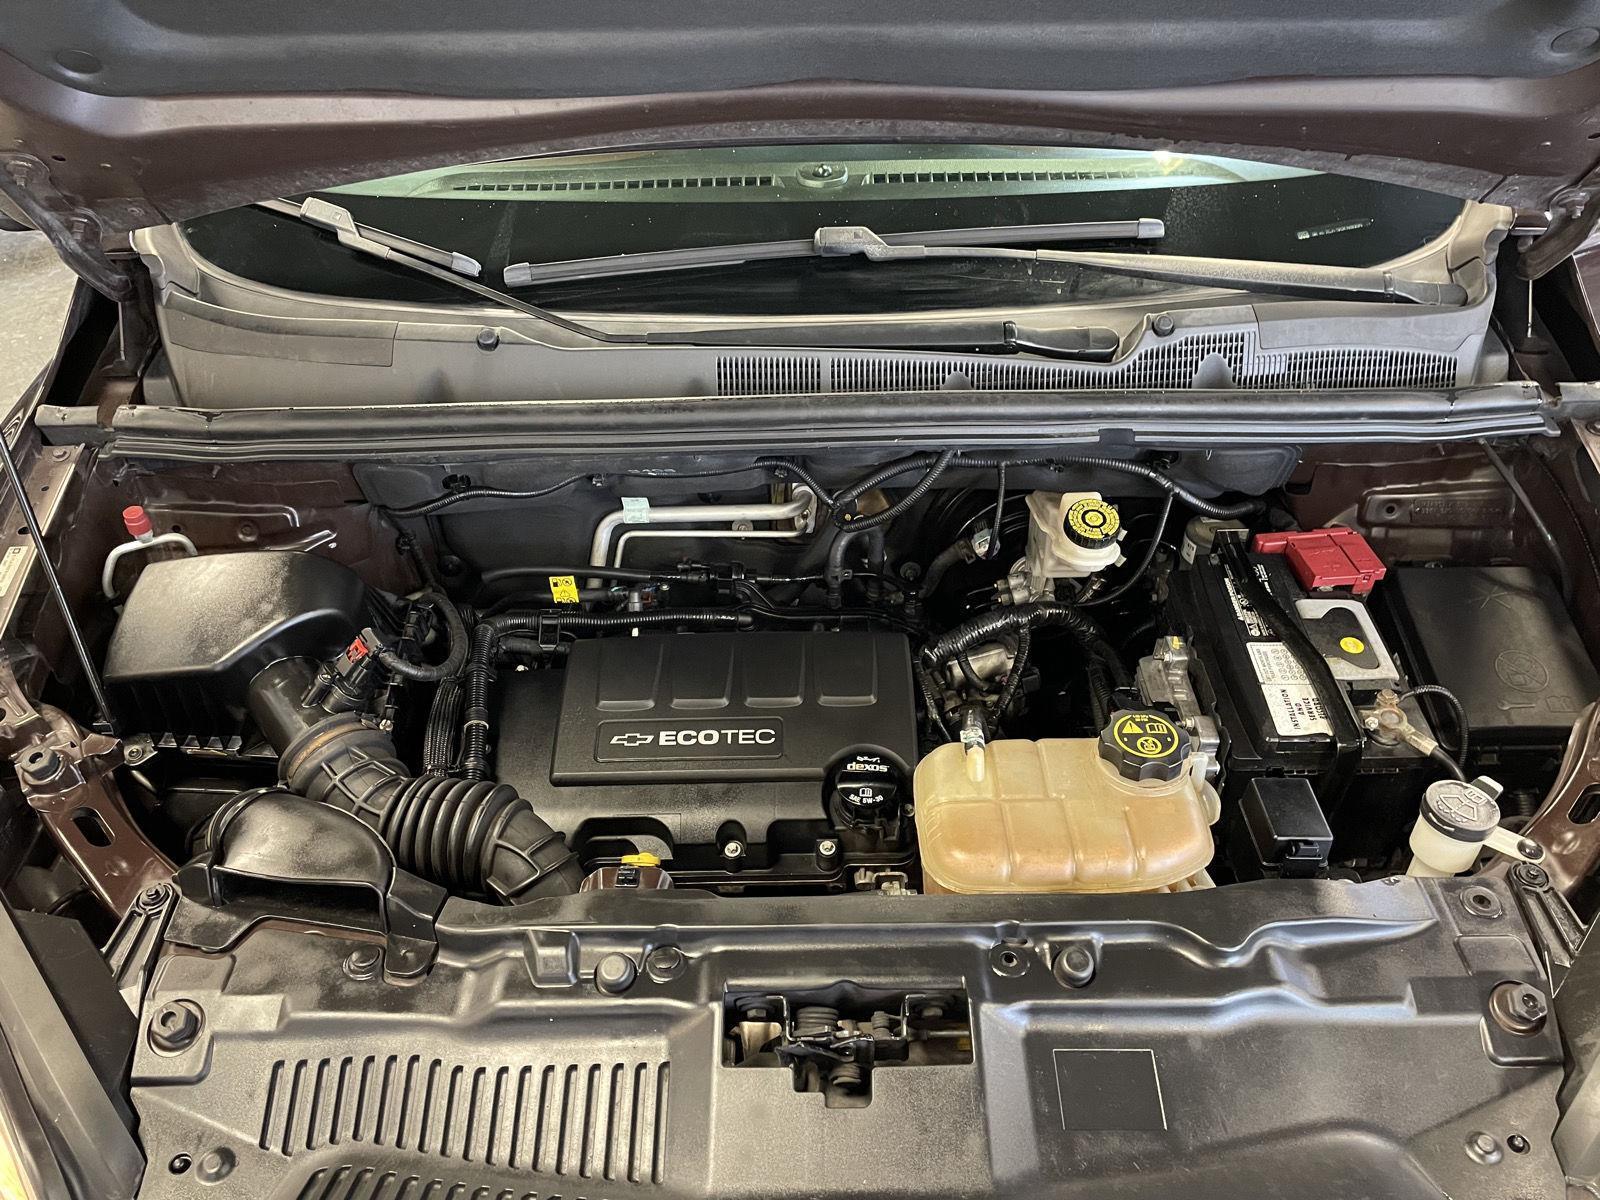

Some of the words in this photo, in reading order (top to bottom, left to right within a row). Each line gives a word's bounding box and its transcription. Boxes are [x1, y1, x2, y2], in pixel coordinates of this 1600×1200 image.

[1280, 689, 1301, 730] INSTALLATION
[1294, 702, 1305, 716] AND
[1302, 697, 1317, 721] SERVICE
[659, 728, 776, 746] ECOTEC
[846, 761, 888, 772] dexos
[849, 793, 861, 803] SAE
